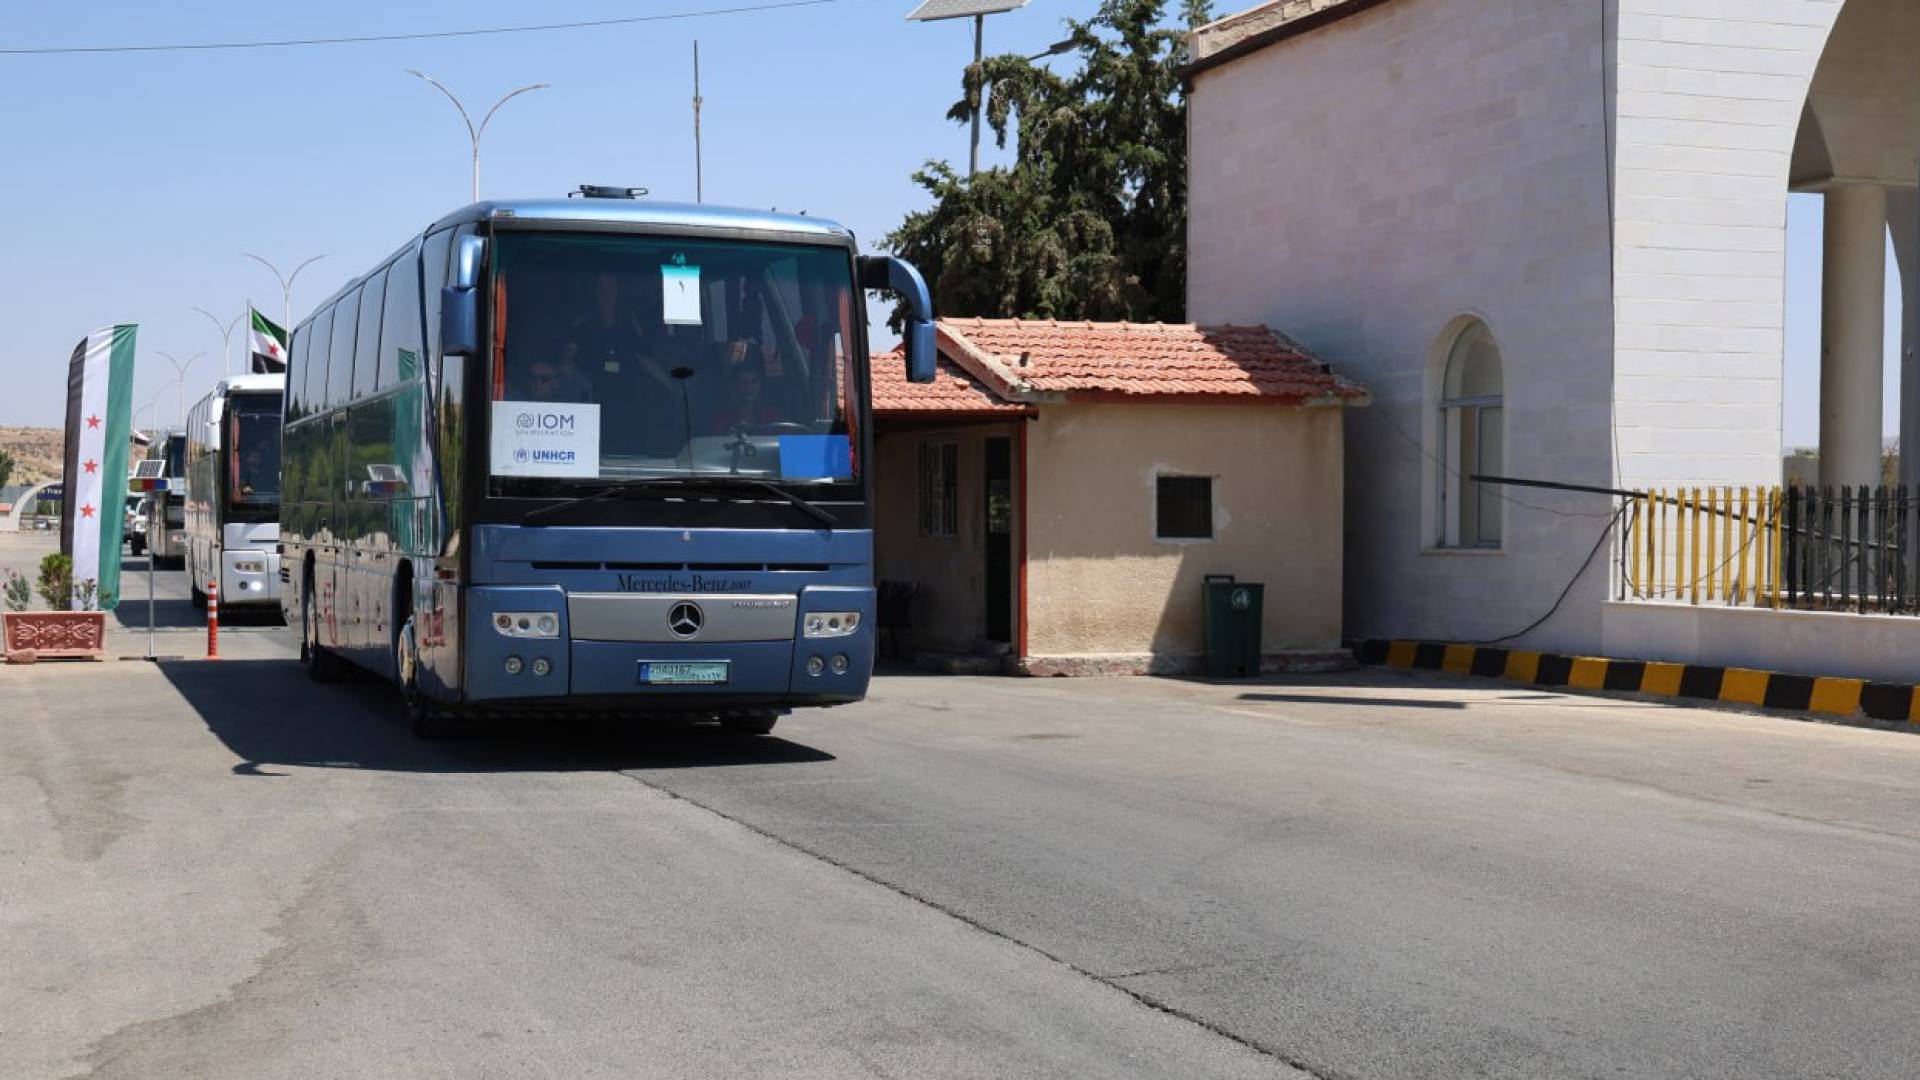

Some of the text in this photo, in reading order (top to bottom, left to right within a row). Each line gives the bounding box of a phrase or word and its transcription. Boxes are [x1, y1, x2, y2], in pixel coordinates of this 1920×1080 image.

[538, 414, 575, 429] IOM
[533, 450, 575, 461] UNHCR
[617, 574, 728, 593] Mercedes-Benz
